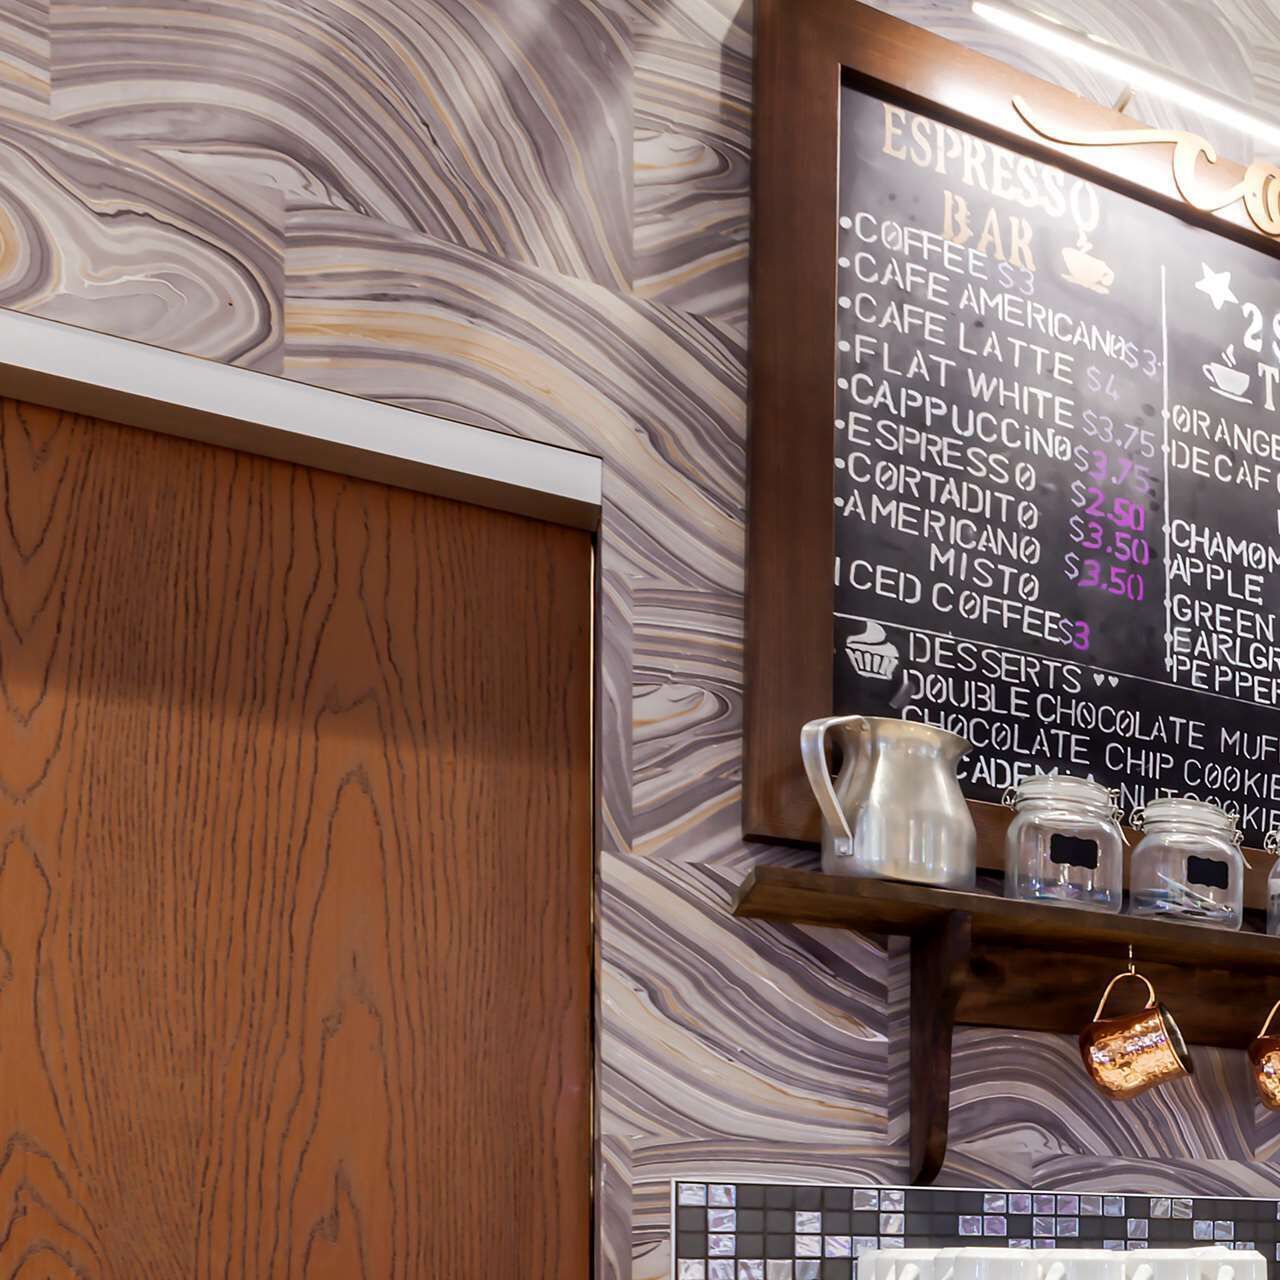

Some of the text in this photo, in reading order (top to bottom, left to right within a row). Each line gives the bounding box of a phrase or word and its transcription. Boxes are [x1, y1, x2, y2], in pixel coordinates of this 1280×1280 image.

[882, 102, 1100, 233] ESPRESSO
[855, 211, 1036, 296] COFFEE $3
[943, 189, 1037, 272] BAR
[854, 250, 951, 307] CAFE
[959, 284, 1126, 361] AMERICANO
[854, 292, 1120, 401] CAFE LATTE $4
[854, 333, 1156, 458] FLAT WHITE $3.75
[848, 411, 1036, 492] ESPRESSO
[1171, 439, 1271, 492] DECAF
[843, 488, 1041, 565] AMERICANO
[847, 451, 1150, 566] CORTADITO $3.50
[834, 556, 922, 605] ICED
[931, 582, 1062, 643] COFFEE
[930, 543, 1040, 602] MISTO
[1169, 552, 1265, 606] APPLE
[1172, 593, 1276, 643] GREEN
[910, 631, 1083, 694] DESSERTS
[902, 669, 1031, 719] DOUBLE
[1036, 693, 1206, 750] CHOCOLATE
[1105, 743, 1175, 780] CHIP
